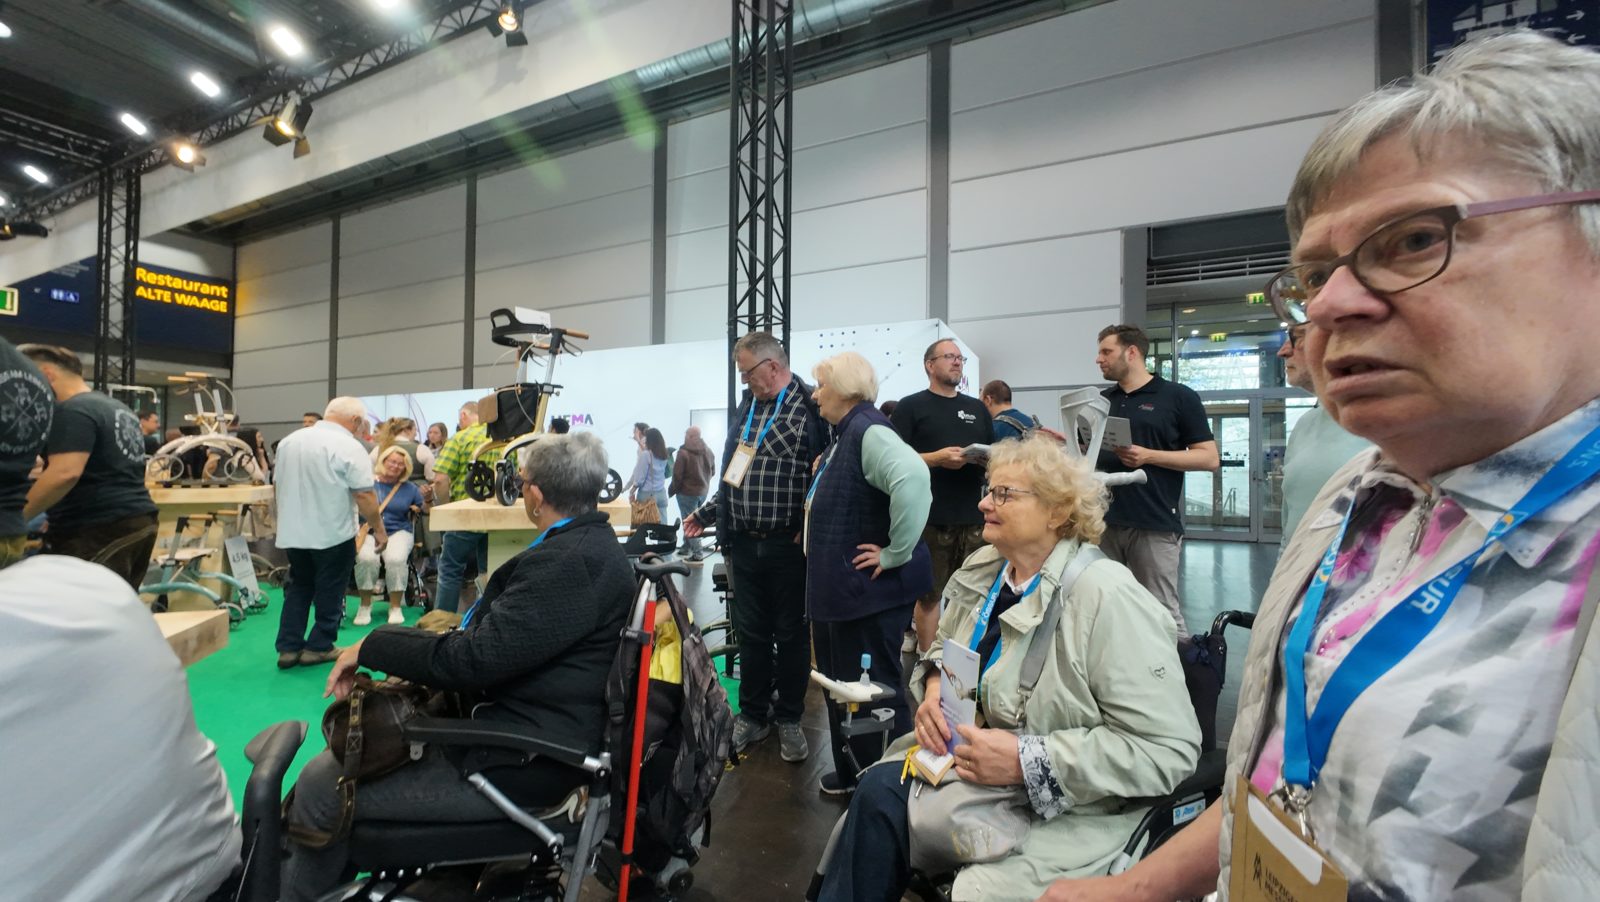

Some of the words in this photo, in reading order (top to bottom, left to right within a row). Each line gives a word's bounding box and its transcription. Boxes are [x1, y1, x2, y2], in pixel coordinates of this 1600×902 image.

[135, 267, 228, 298] Restaurant
[135, 285, 172, 303] ALTE
[174, 292, 228, 313] WAAGE
